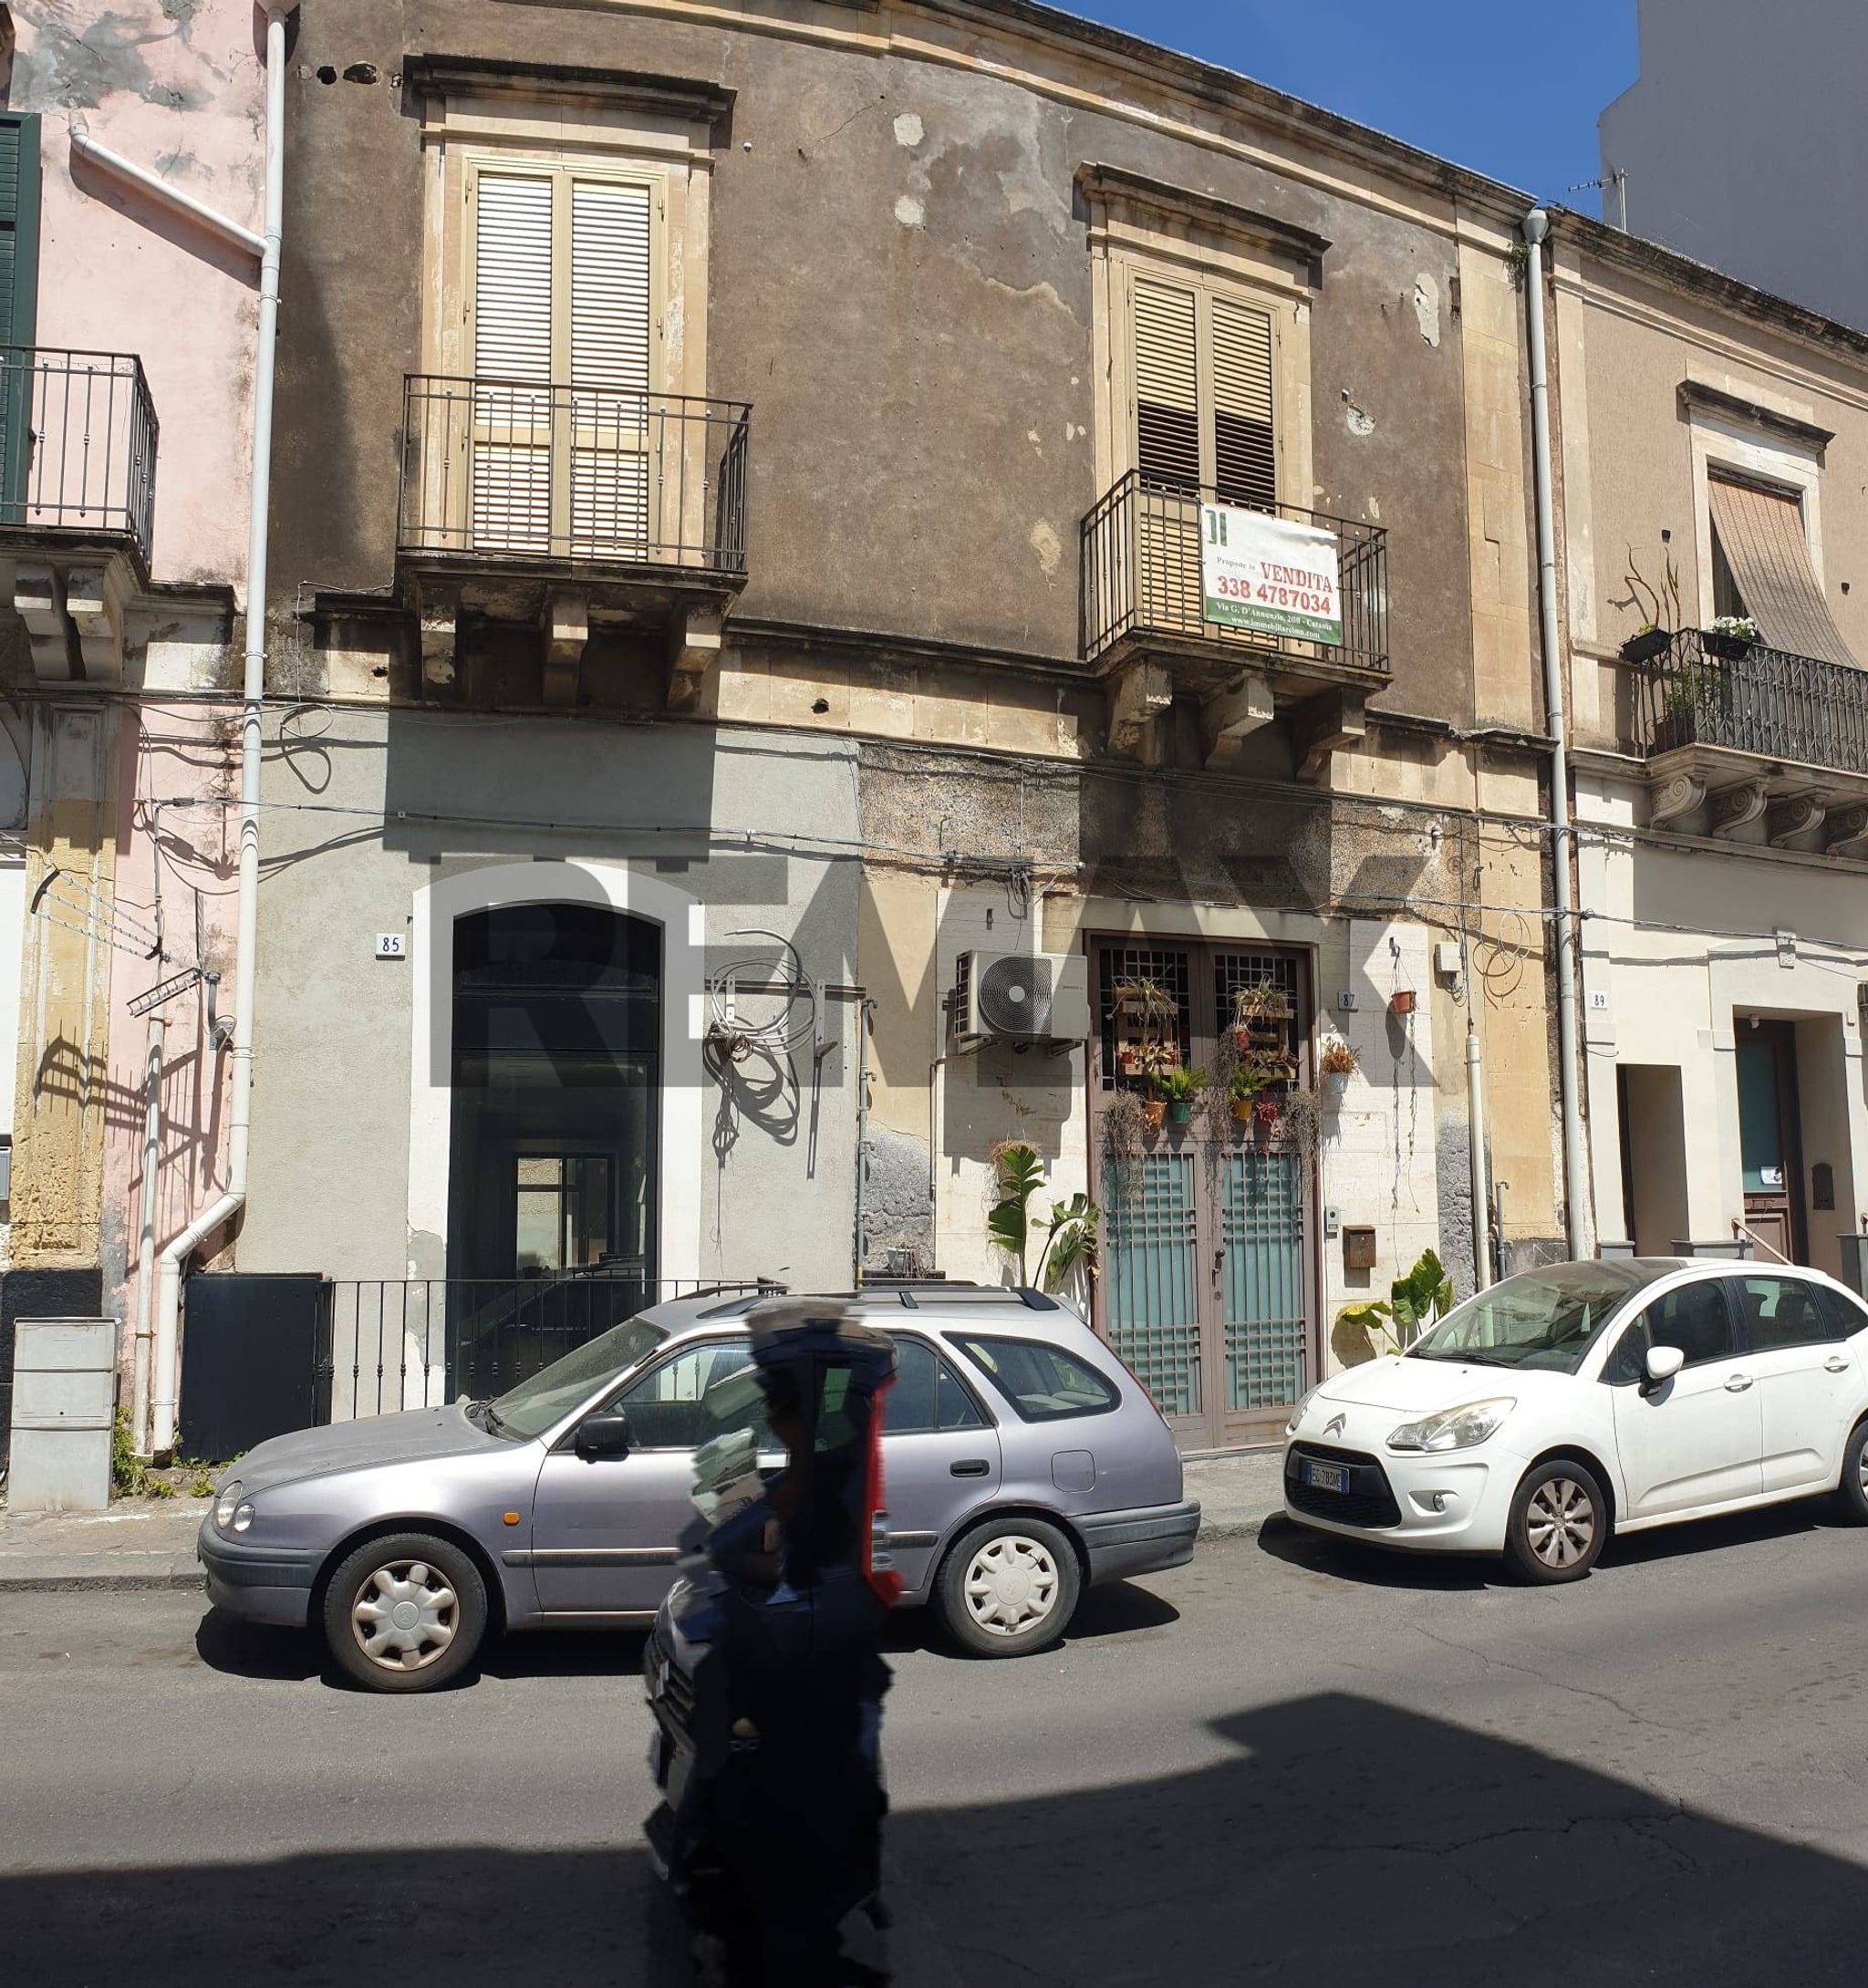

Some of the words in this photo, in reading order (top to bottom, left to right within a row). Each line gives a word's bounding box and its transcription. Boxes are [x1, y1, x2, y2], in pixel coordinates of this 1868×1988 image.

[1261, 561, 1334, 593] VENDITA
[1217, 575, 1251, 599] 338
[1256, 584, 1332, 615] 4787034
[1216, 602, 1229, 612] Via
[382, 937, 400, 952] 85
[1344, 994, 1355, 1007] 87
[1593, 994, 1604, 1007] 89
